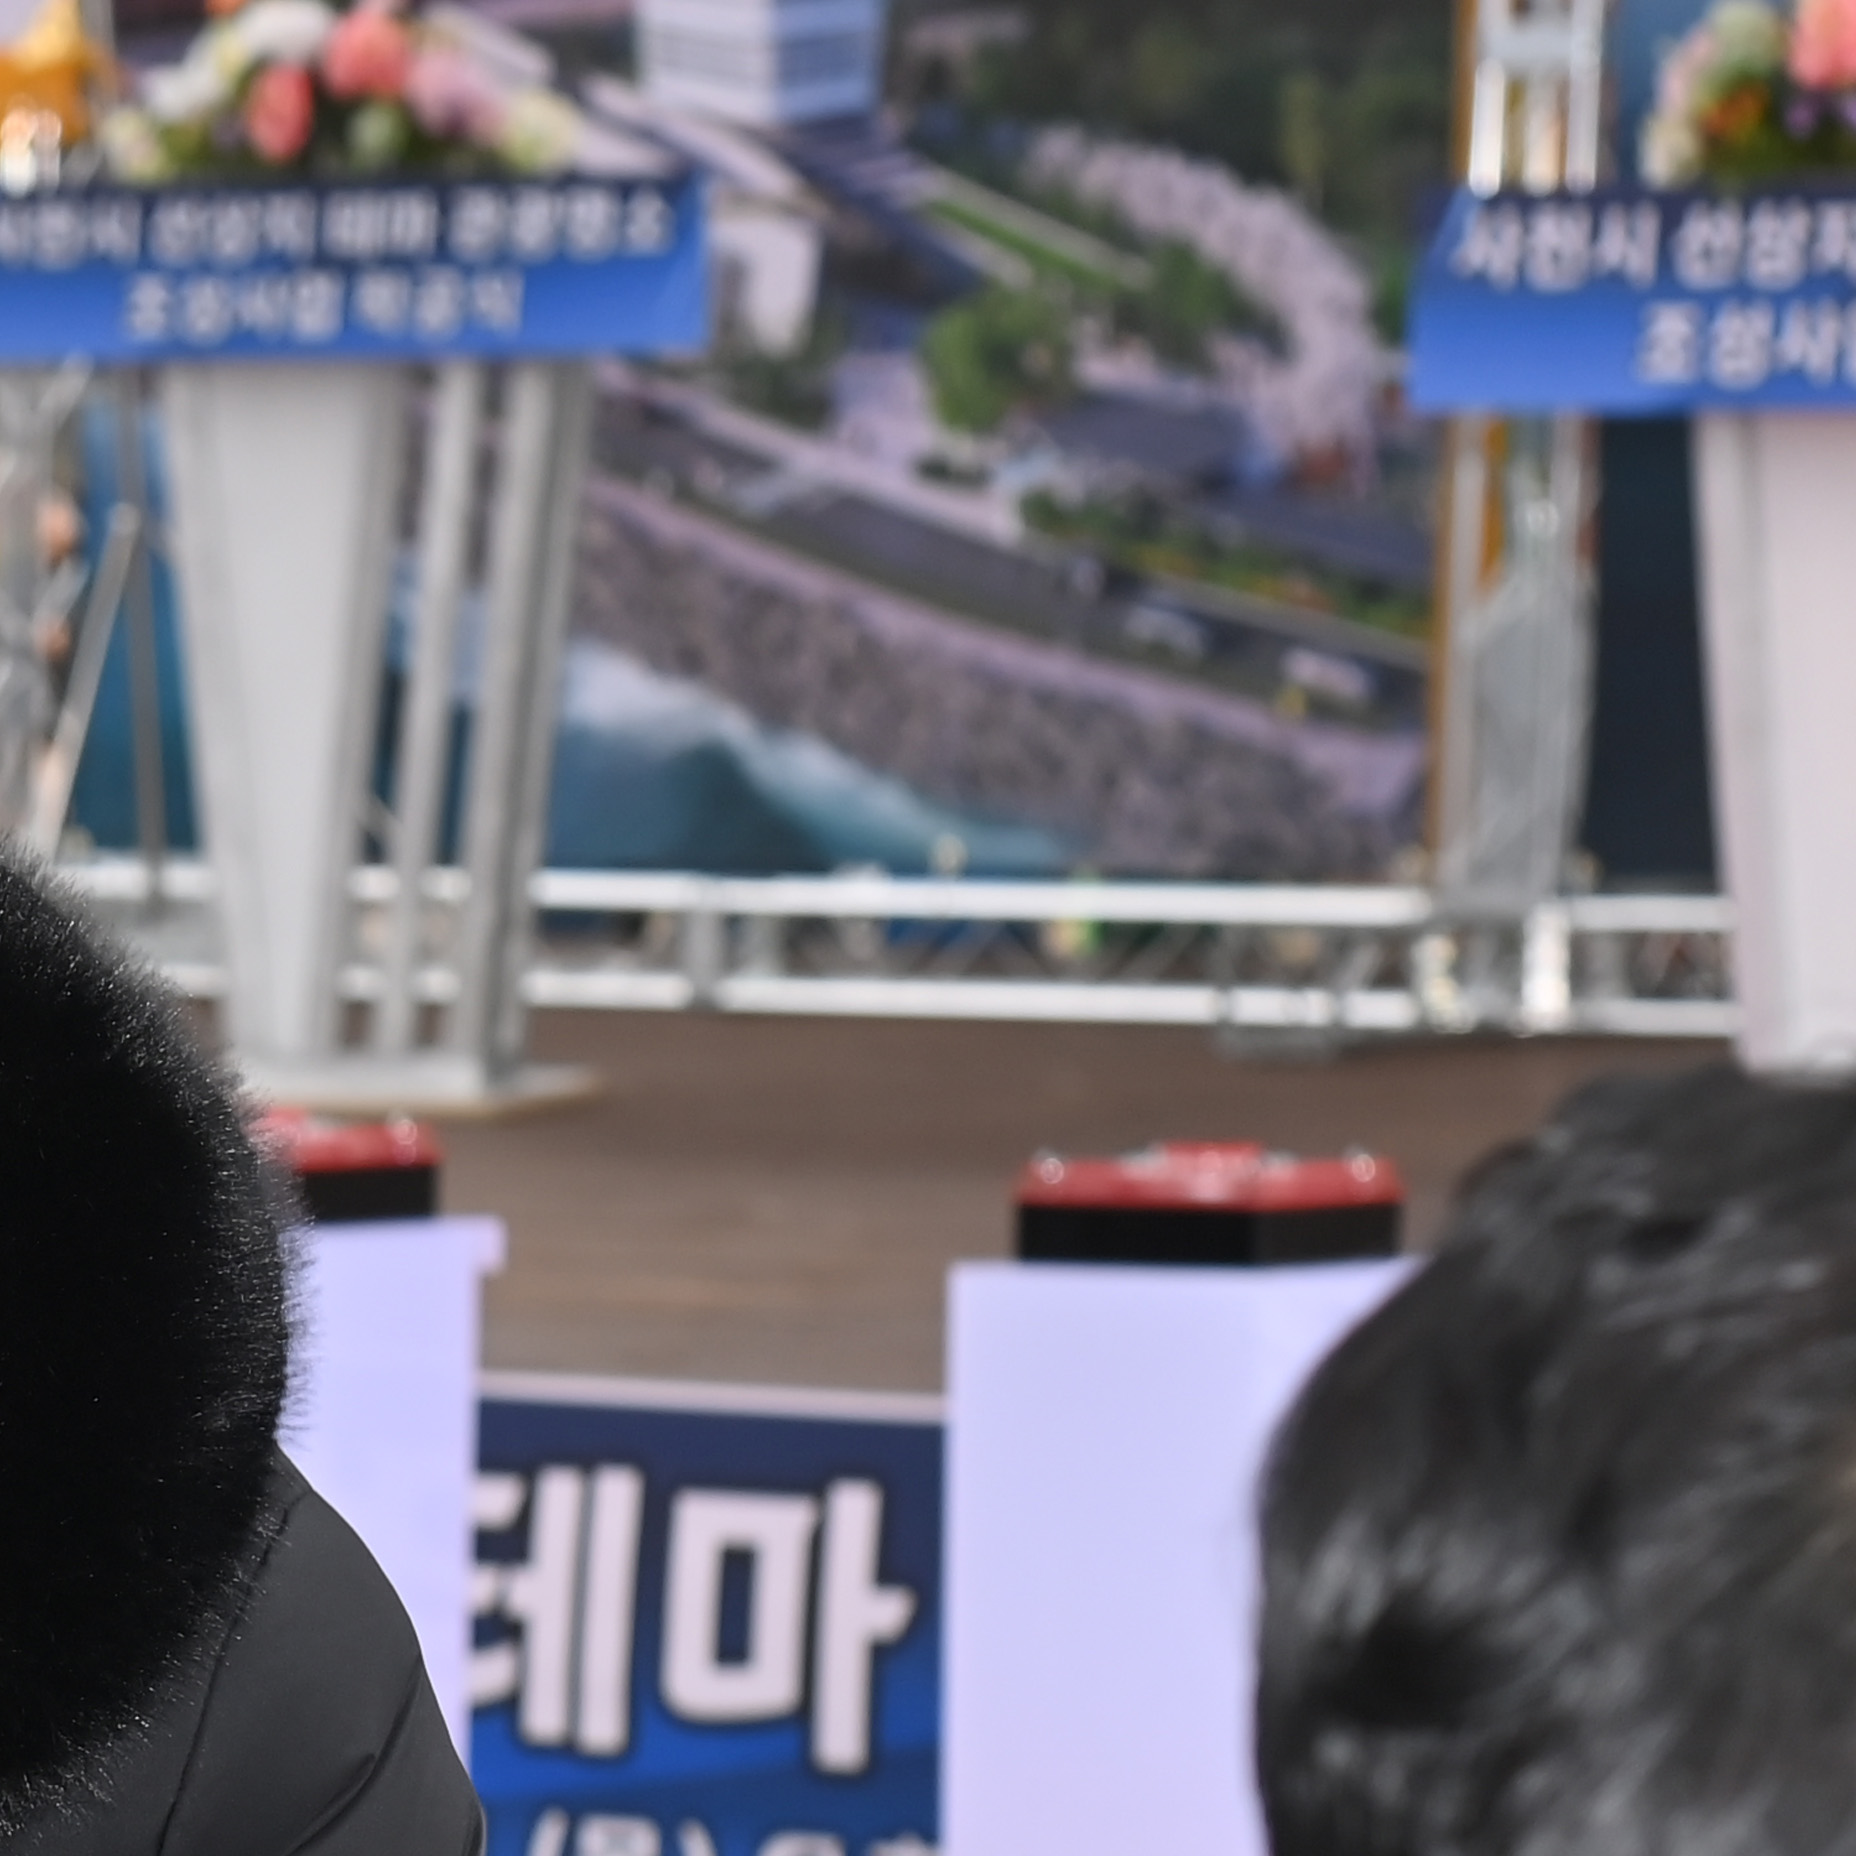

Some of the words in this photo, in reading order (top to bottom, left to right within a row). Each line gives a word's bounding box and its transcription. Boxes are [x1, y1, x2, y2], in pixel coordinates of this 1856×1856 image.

[324, 190, 438, 258] 테마
[1454, 200, 1660, 290] 사천시
[1638, 299, 1856, 390] 조성사
[469, 1464, 914, 1775] 테마
